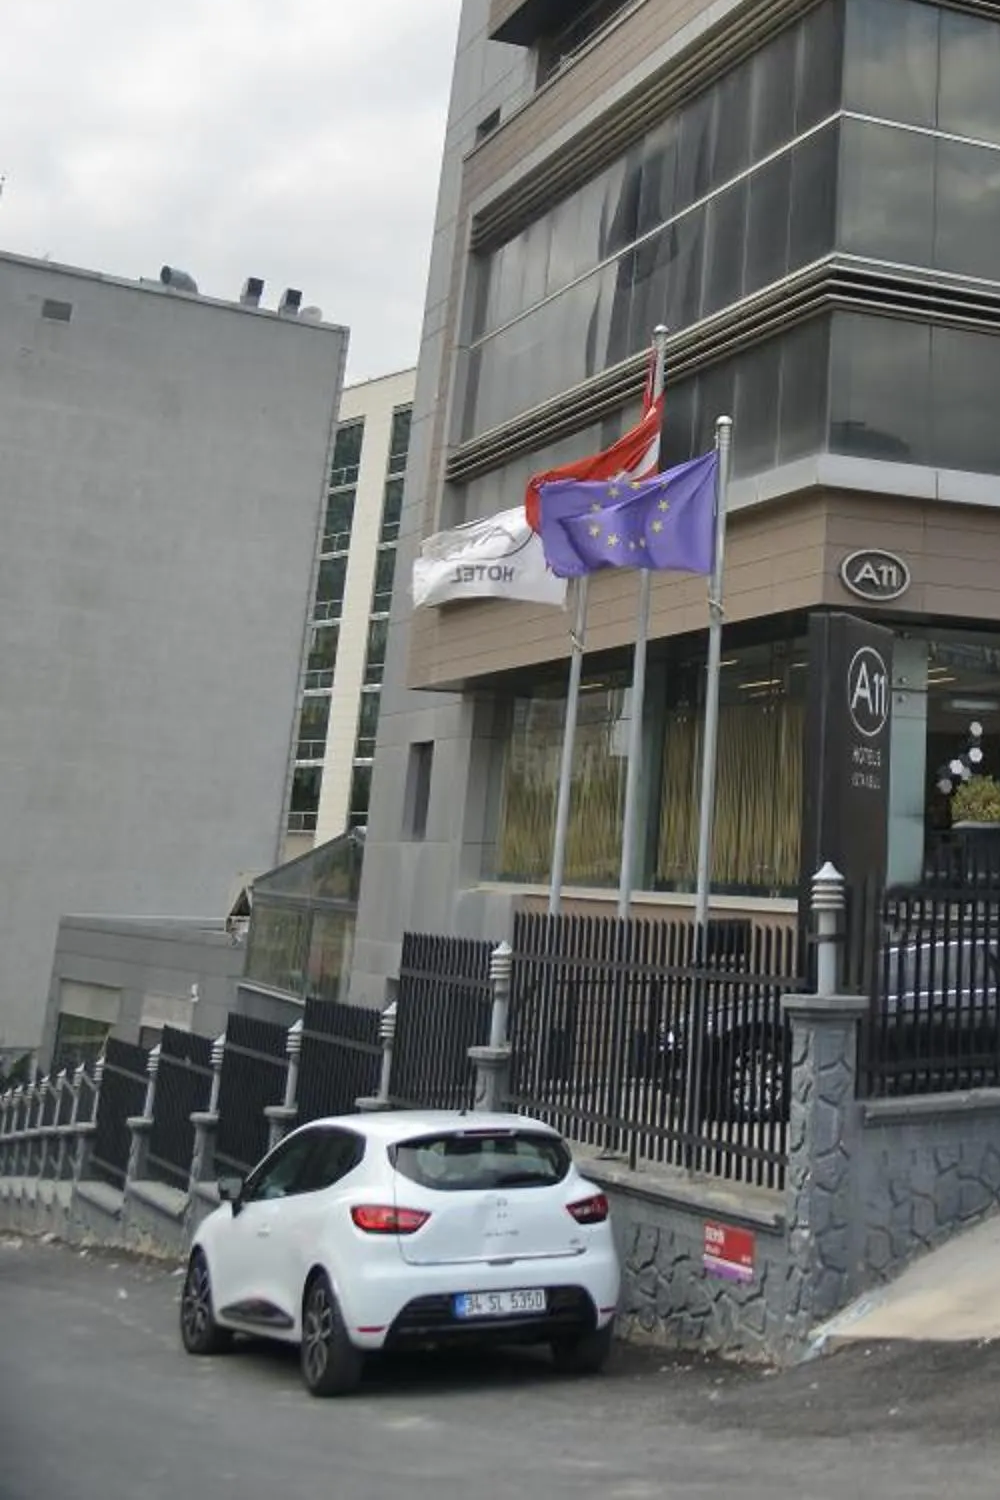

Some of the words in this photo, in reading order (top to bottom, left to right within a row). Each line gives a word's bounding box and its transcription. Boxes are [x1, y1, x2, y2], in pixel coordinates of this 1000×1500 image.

[853, 562, 897, 587] A11
[851, 662, 885, 716] A11
[465, 1293, 483, 1312] 34
